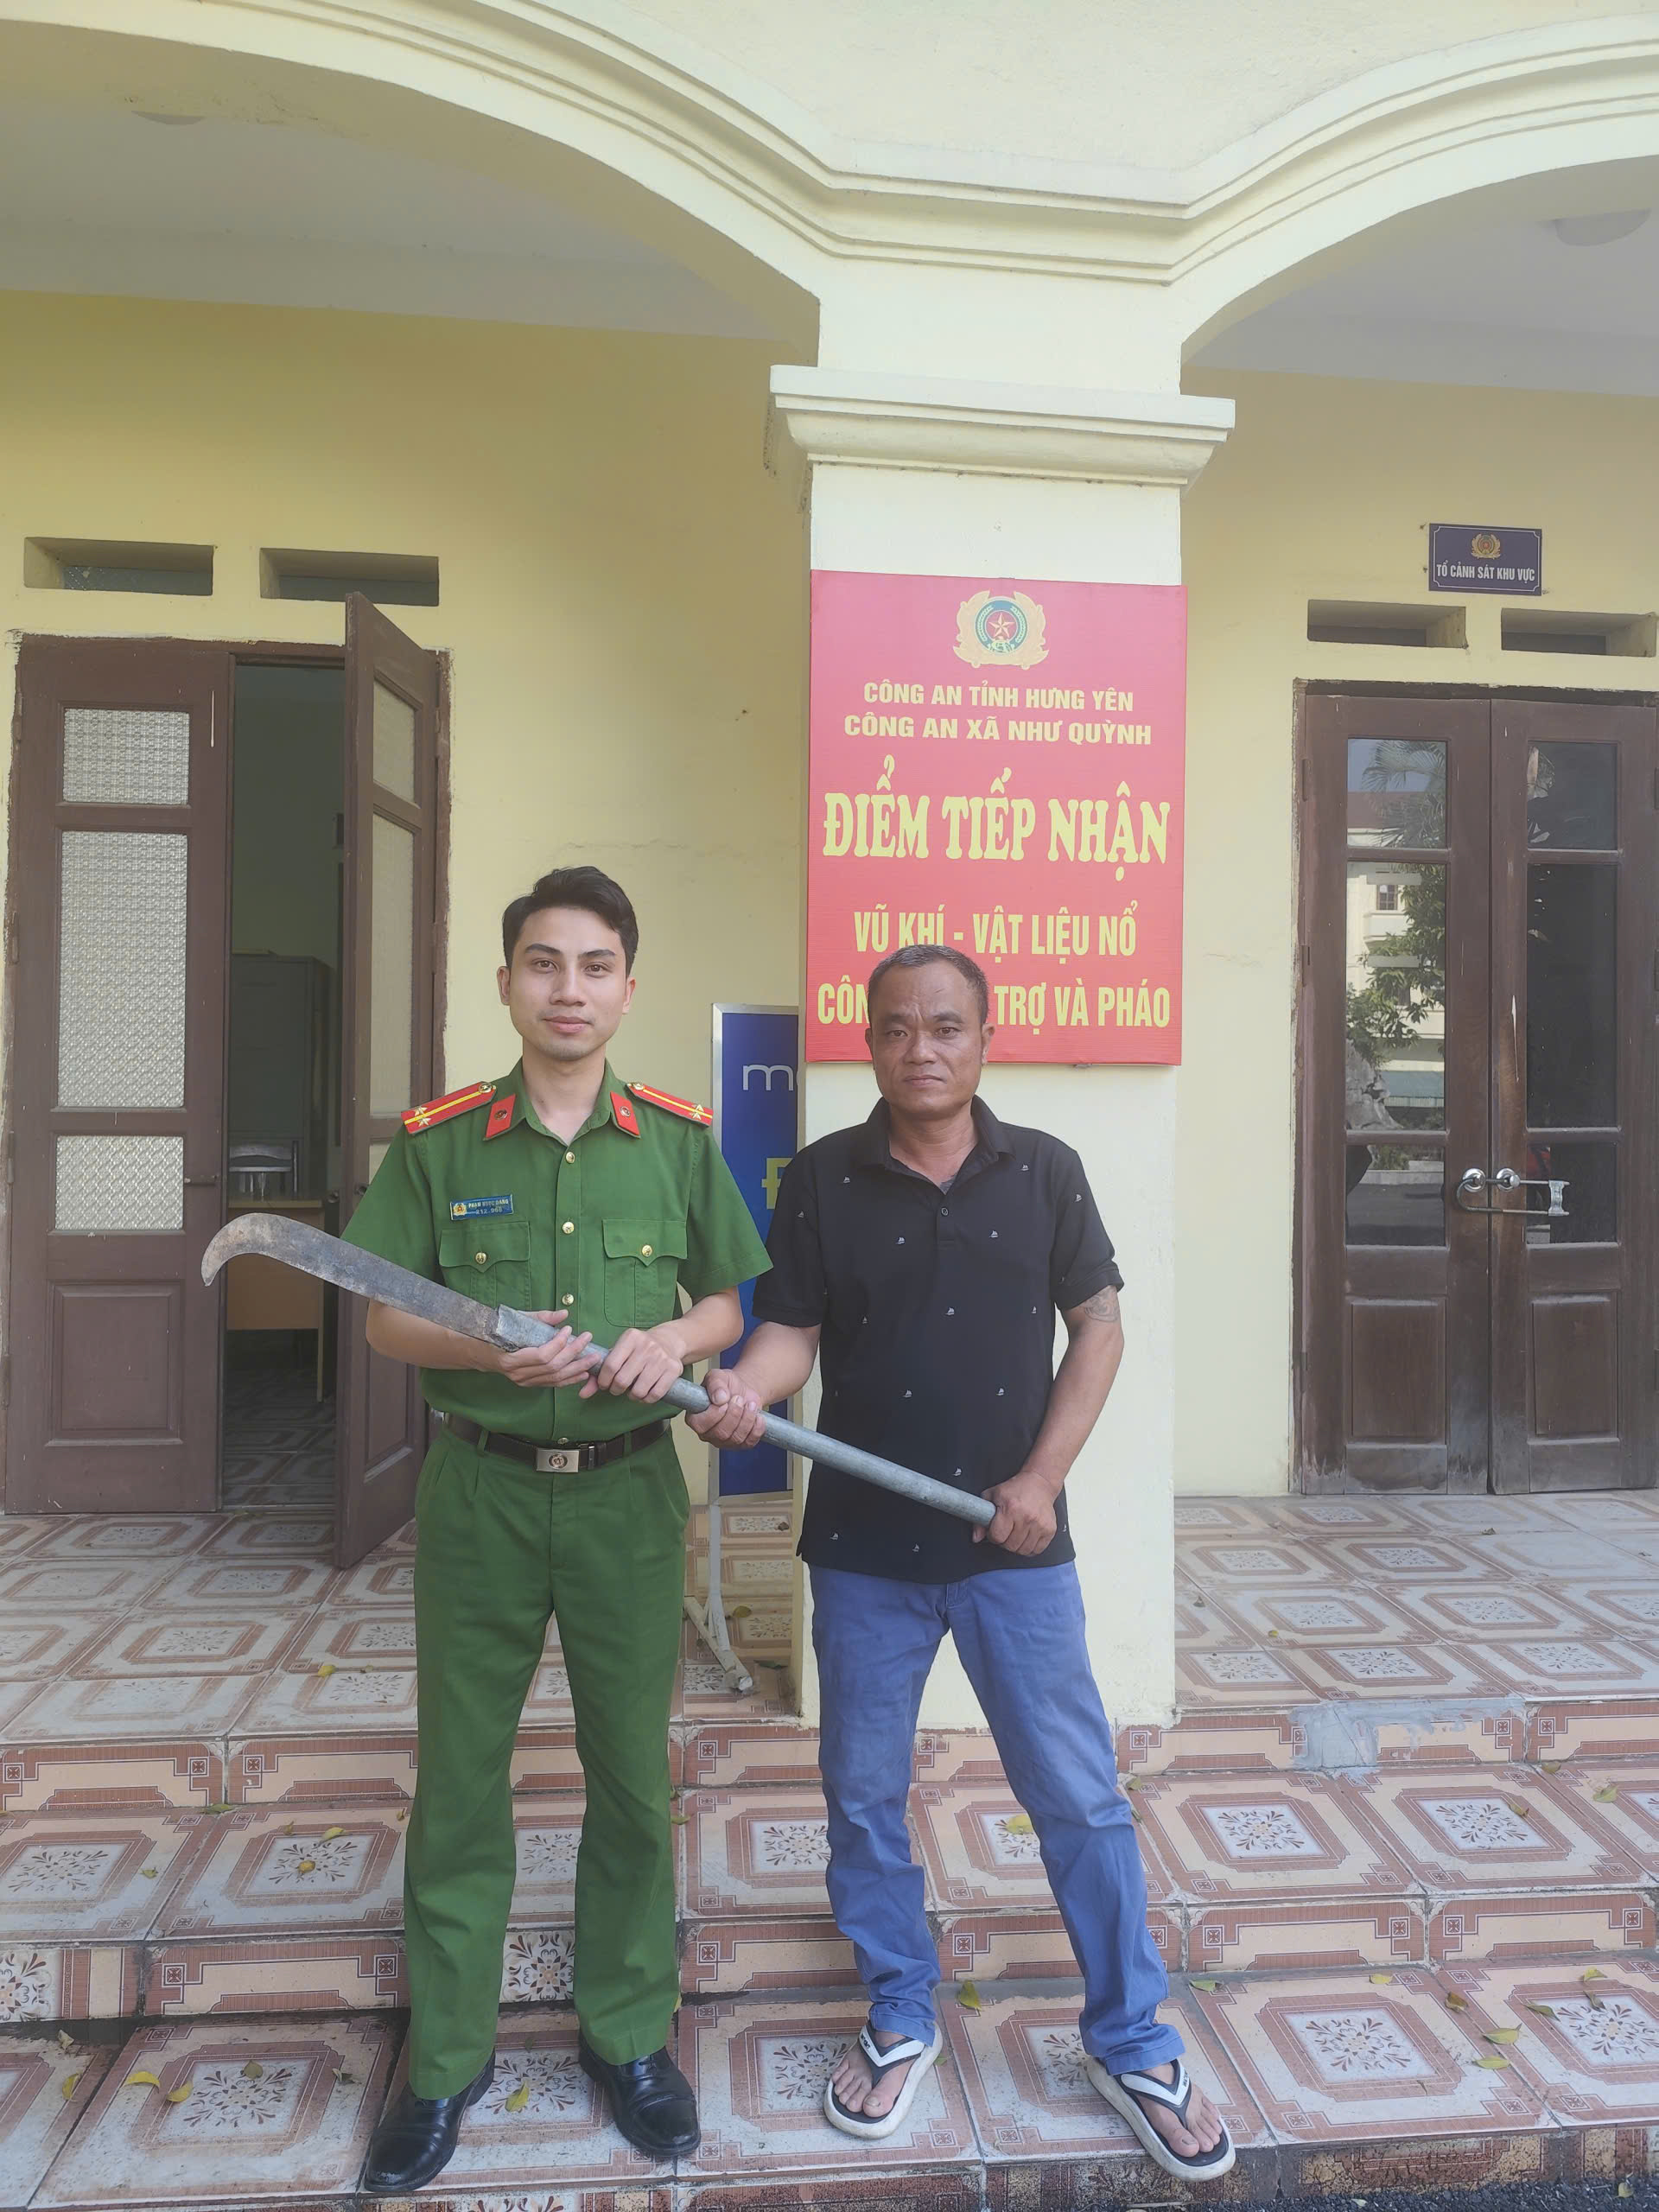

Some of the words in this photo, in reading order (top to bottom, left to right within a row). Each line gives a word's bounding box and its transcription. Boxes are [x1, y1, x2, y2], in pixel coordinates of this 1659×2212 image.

[1437, 560, 1448, 576] TỔ
[1450, 562, 1475, 578] CẢNH
[1478, 564, 1495, 579] SÁT
[1497, 568, 1515, 580] KHU
[1517, 568, 1535, 583] VỰC
[864, 679, 925, 704] CÔNG
[931, 684, 962, 706] AN
[969, 679, 1019, 708] TỈNH
[1026, 688, 1085, 710] HƯNG
[1091, 688, 1134, 712] YÊN
[844, 712, 914, 738] CÔNG
[922, 717, 958, 739] AN
[966, 716, 1000, 741] XÃ
[1008, 720, 1064, 742] NHƯ
[1068, 721, 1152, 745] QUỲNH
[823, 755, 931, 859] ĐIỂM
[941, 767, 1036, 861] TIẾP
[1047, 781, 1171, 881] NHẬN
[854, 904, 889, 953] VŨ
[899, 905, 944, 950] KHÍ
[972, 905, 1023, 963] VẬT
[1031, 907, 1090, 964] LIỆU
[1098, 899, 1138, 957] NỔ
[817, 975, 869, 1024] CÔN
[994, 982, 1046, 1035] TRỢ
[1054, 978, 1090, 1027] VÀ
[1097, 978, 1170, 1027] PHÁO
[742, 1065, 798, 1091] m
